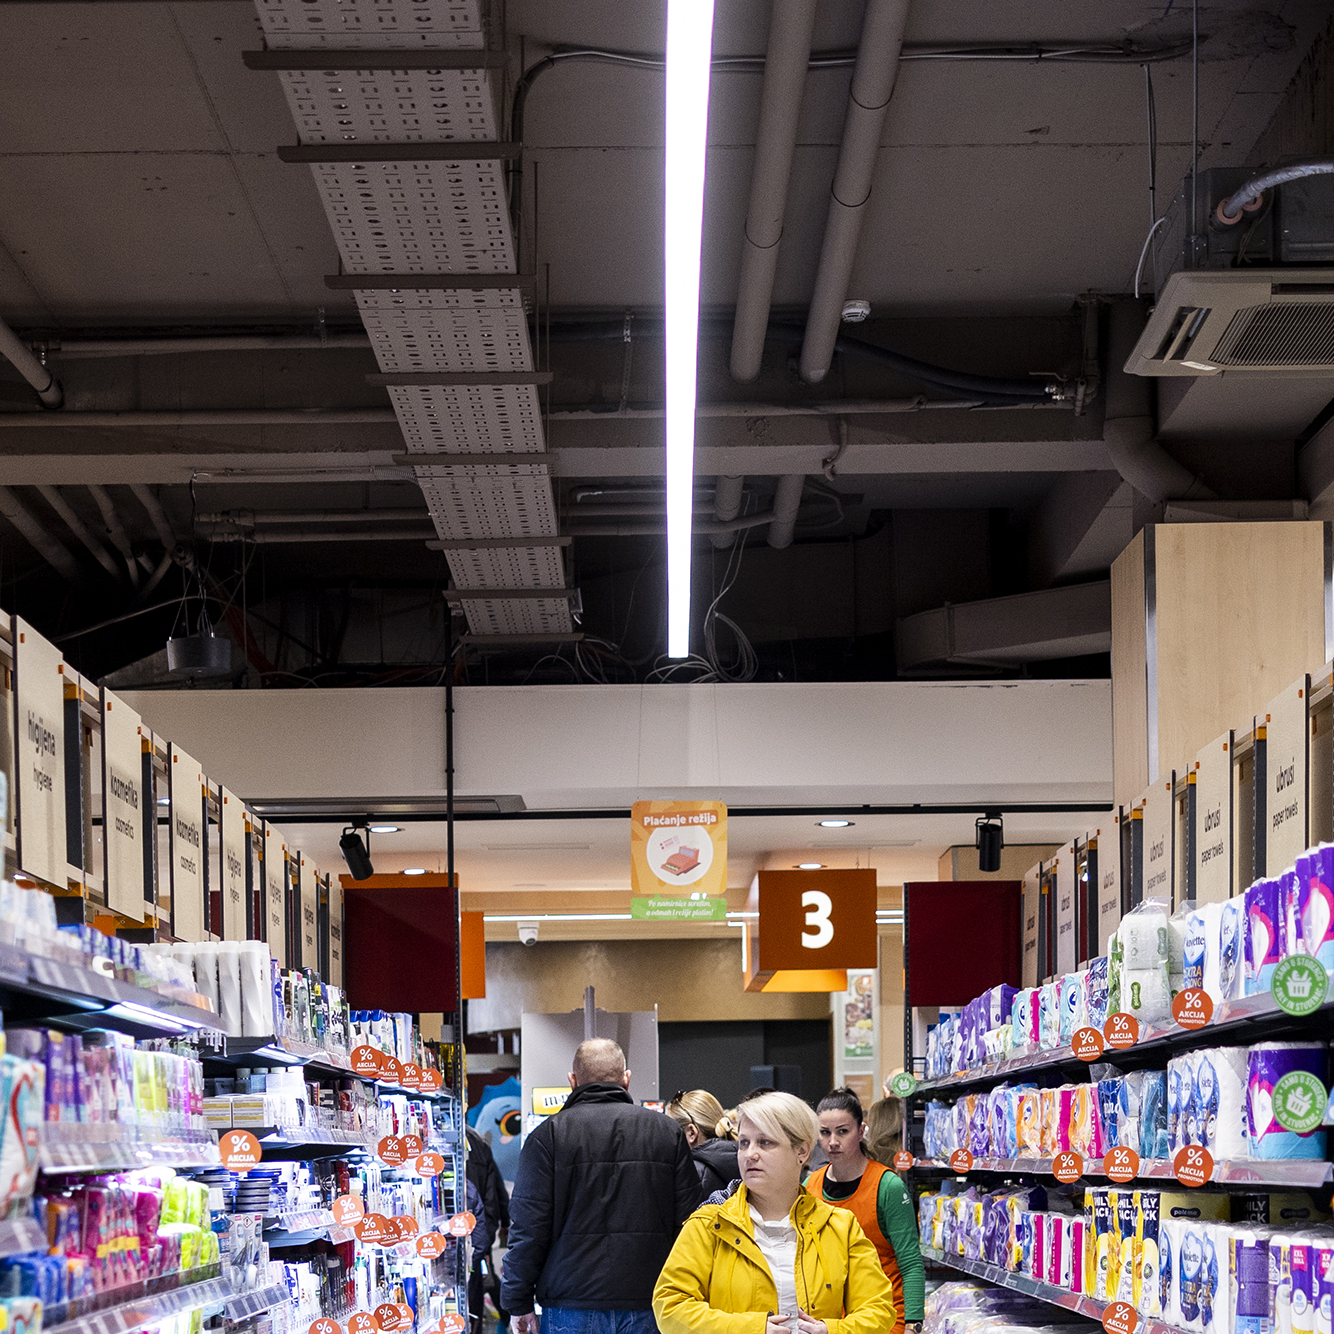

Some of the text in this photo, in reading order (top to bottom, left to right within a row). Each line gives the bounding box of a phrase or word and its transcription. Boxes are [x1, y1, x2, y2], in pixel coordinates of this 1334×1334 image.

[27, 710, 56, 757] higijena
[32, 766, 54, 792] hygiene
[1275, 756, 1295, 794] ubrusi
[110, 766, 139, 810] kozmetika
[643, 812, 717, 827] Plaćanje režija
[1204, 802, 1221, 834] ubrusi
[1272, 798, 1299, 830] paper towels
[175, 812, 200, 849] kozmetika
[1149, 834, 1165, 862] ubrusi
[801, 890, 835, 949] 3
[1275, 962, 1291, 980] SAMO
[1178, 1010, 1206, 1019] AKCIJA
[1077, 1045, 1100, 1053] AKCIJA
[1280, 1075, 1299, 1090] SAMO
[227, 1154, 256, 1162] AKCIJA
[1109, 1165, 1134, 1173] AKCIJA
[1178, 1166, 1205, 1178] AKCIJA
[1177, 1173, 1204, 1184] PROMOTION
[1293, 1257, 1305, 1265] ROLL
[382, 1316, 400, 1326] AKCIJA
[1106, 1318, 1129, 1332] AKCIJA
